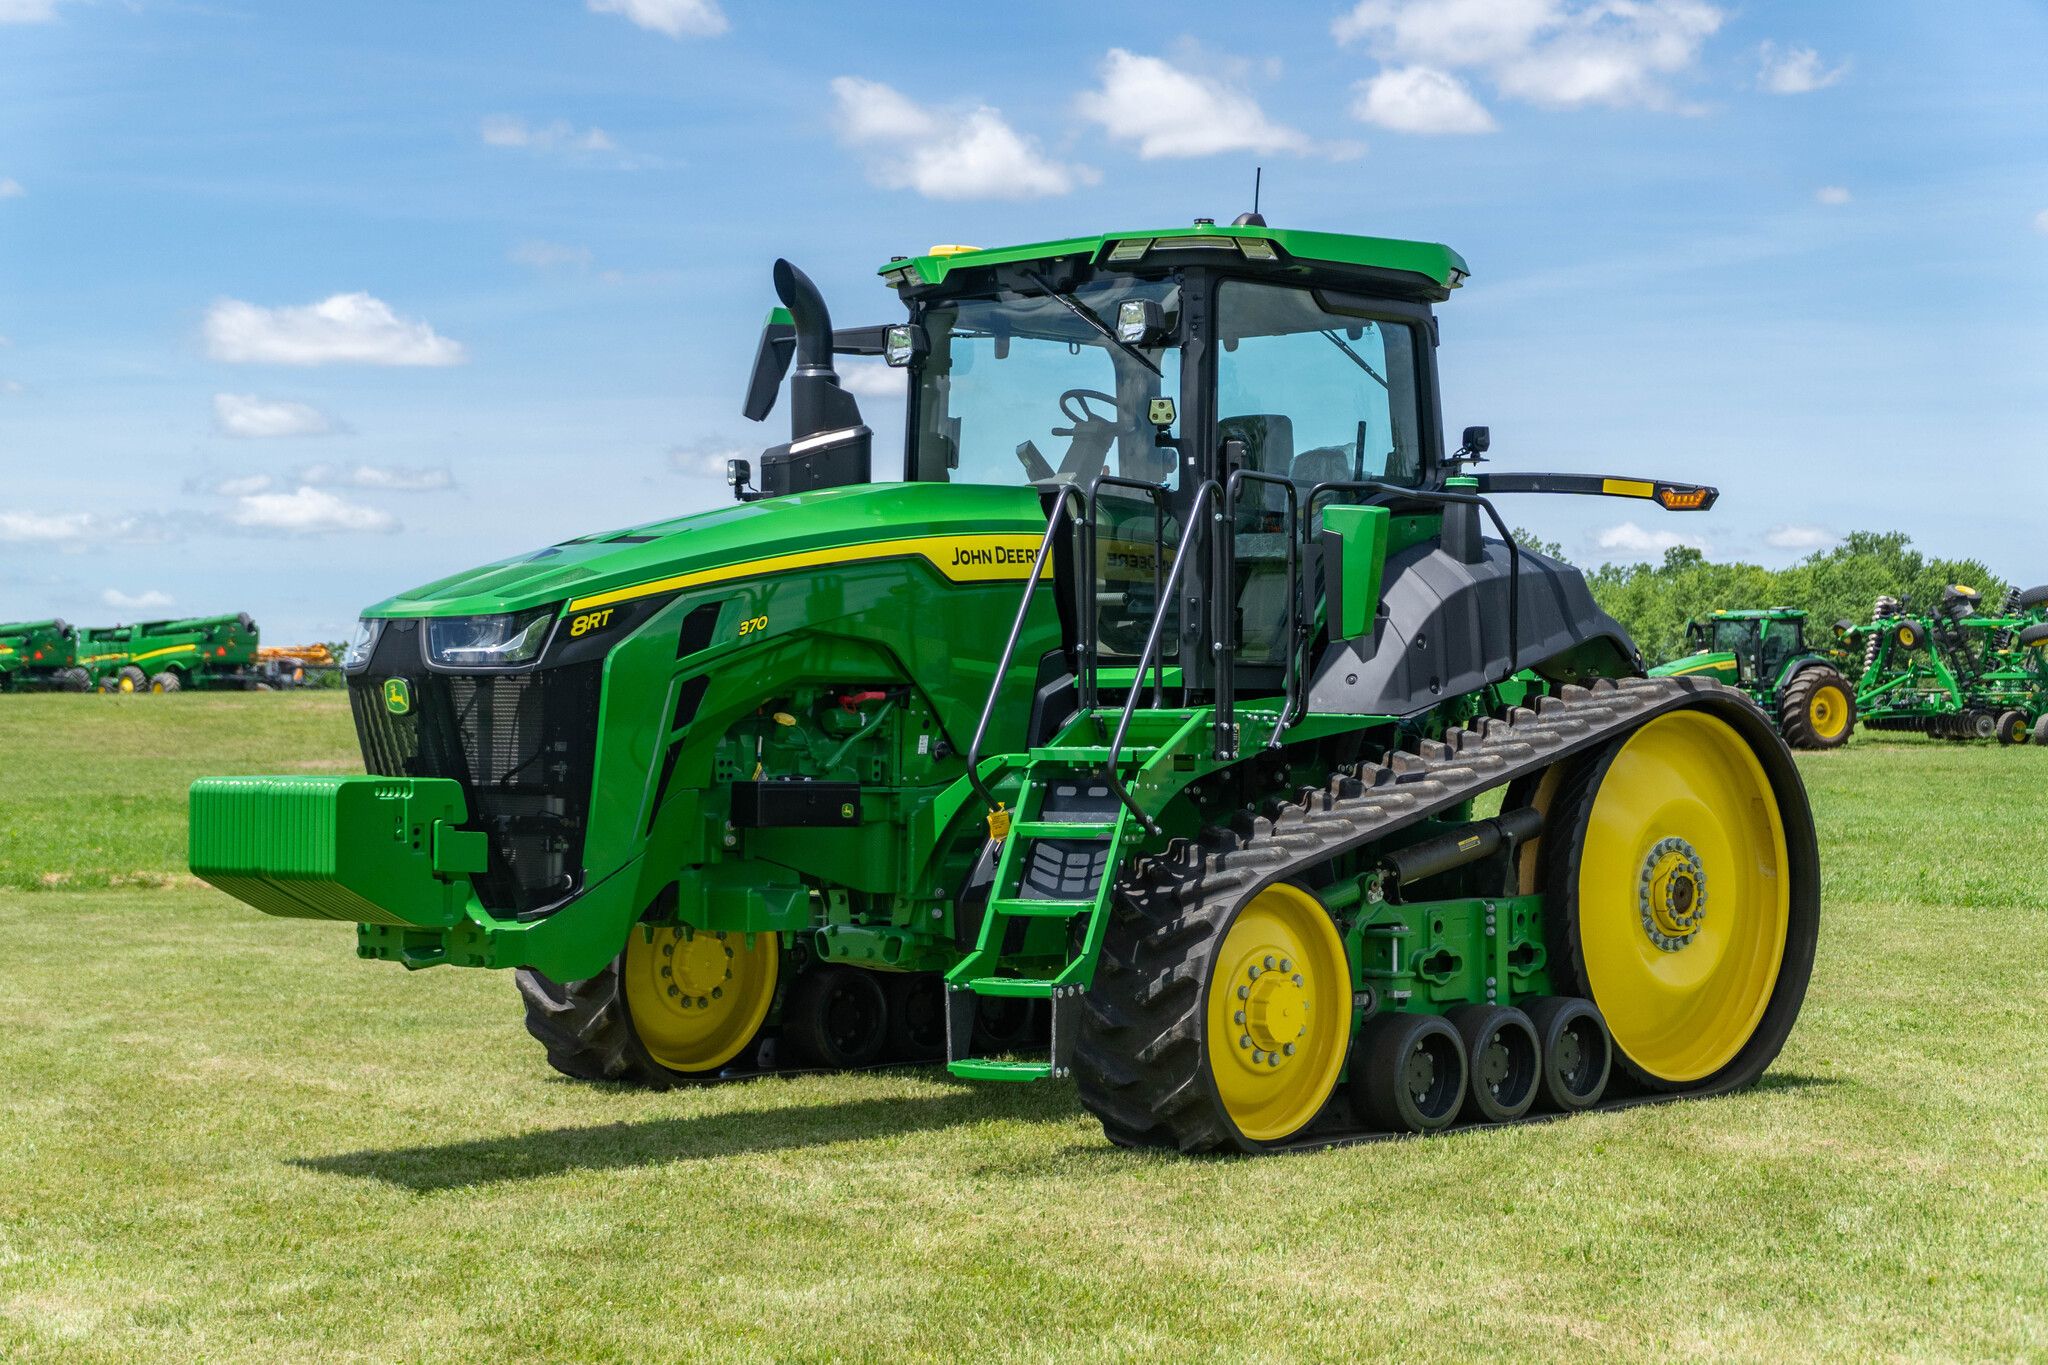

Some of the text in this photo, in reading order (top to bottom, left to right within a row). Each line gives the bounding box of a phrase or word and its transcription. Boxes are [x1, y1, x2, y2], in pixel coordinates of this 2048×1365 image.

[951, 547, 992, 565] JOHN
[570, 609, 614, 637] 8RT
[738, 615, 768, 636] 370
